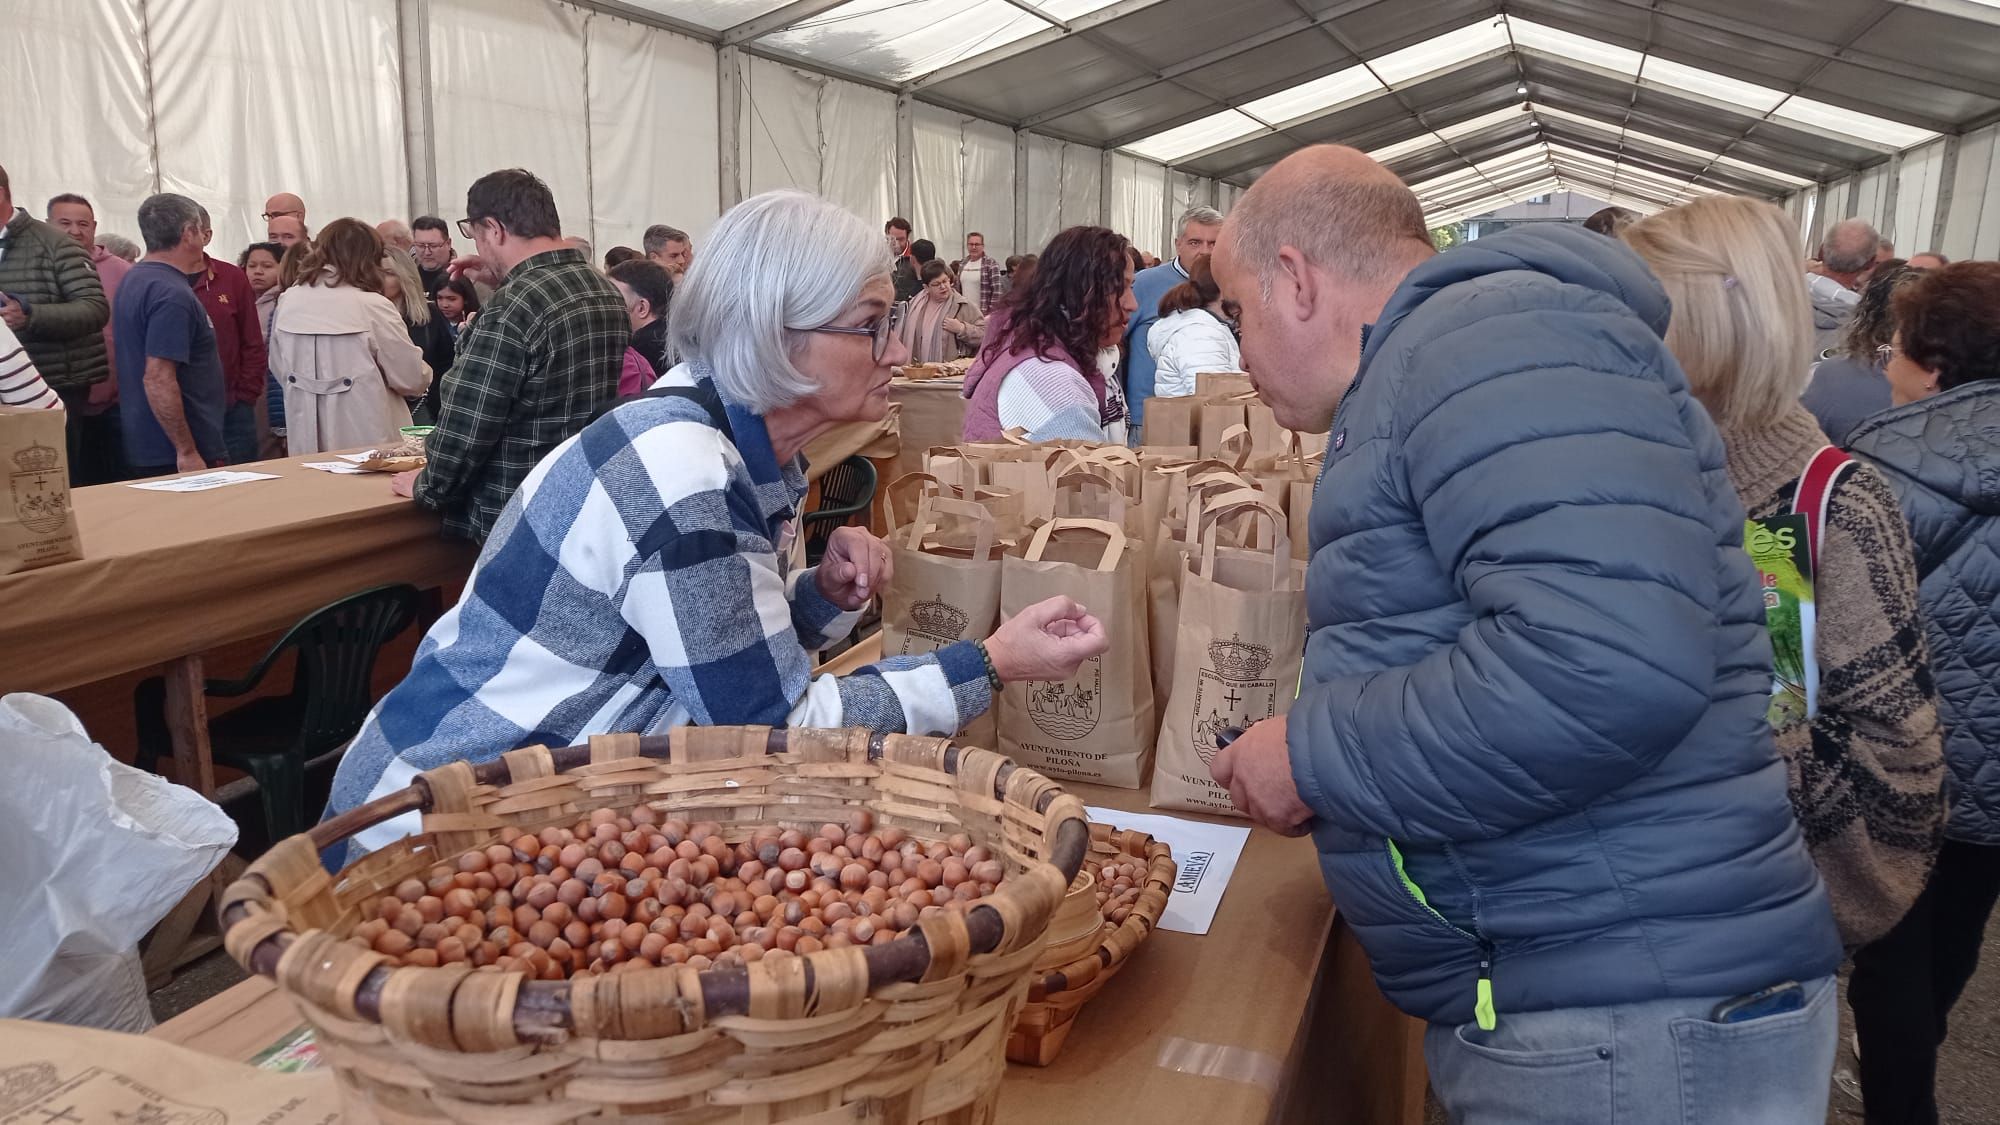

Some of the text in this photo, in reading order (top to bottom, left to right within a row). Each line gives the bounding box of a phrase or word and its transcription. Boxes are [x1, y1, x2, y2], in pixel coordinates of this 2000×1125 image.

[1020, 743, 1108, 761] AYUNTAMIENTO DE
[1046, 756, 1081, 768] PILOÑA
[1181, 774, 1221, 788] AYUNTA
[1208, 790, 1232, 800] PILO
[1186, 797, 1236, 811] www.ayto-p
